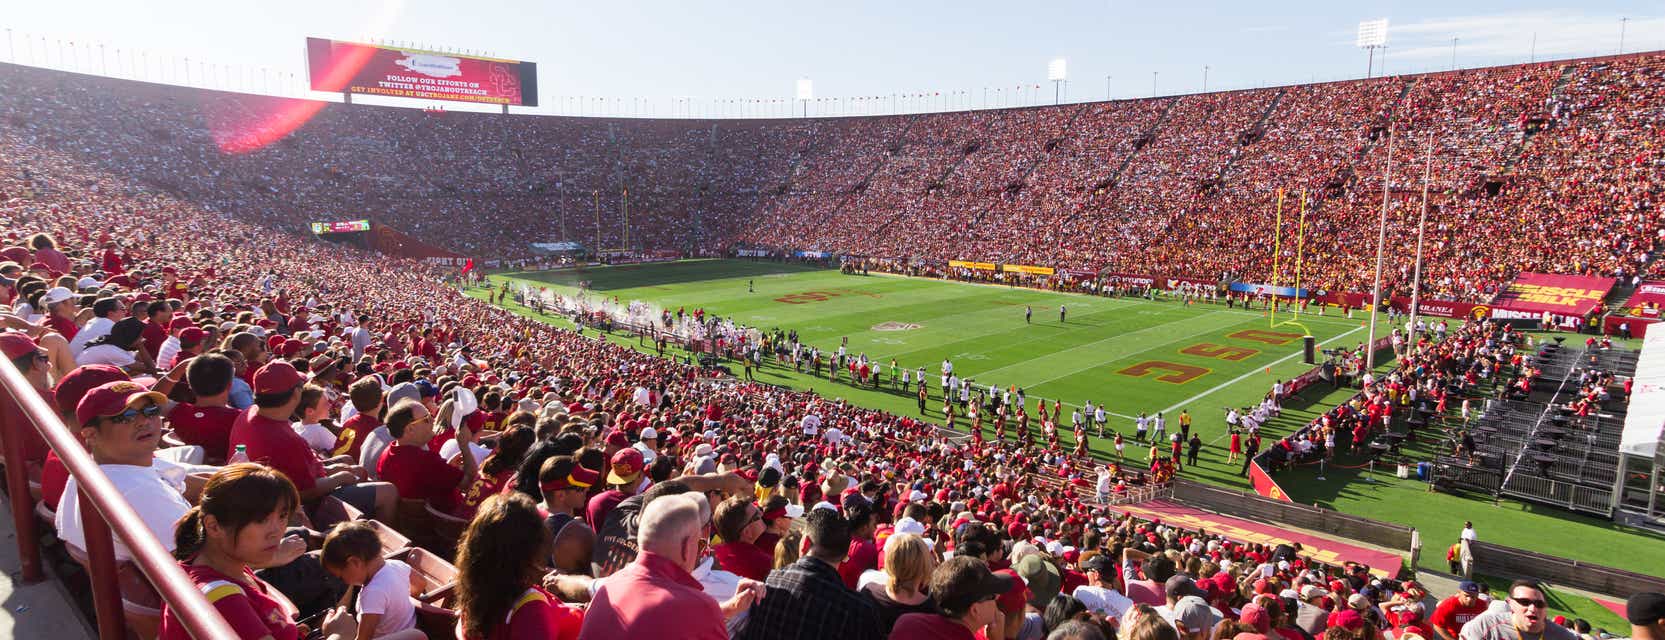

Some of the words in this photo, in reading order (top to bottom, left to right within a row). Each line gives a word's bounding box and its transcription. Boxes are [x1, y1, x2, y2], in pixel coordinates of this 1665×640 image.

[378, 81, 414, 90] TWITTER
[387, 75, 418, 83] FOLLOW
[437, 79, 468, 87] EFFORTS
[367, 87, 404, 96] INVOLVED
[1407, 303, 1455, 314] TRRANEA
[1492, 307, 1541, 319] MUSCLE
